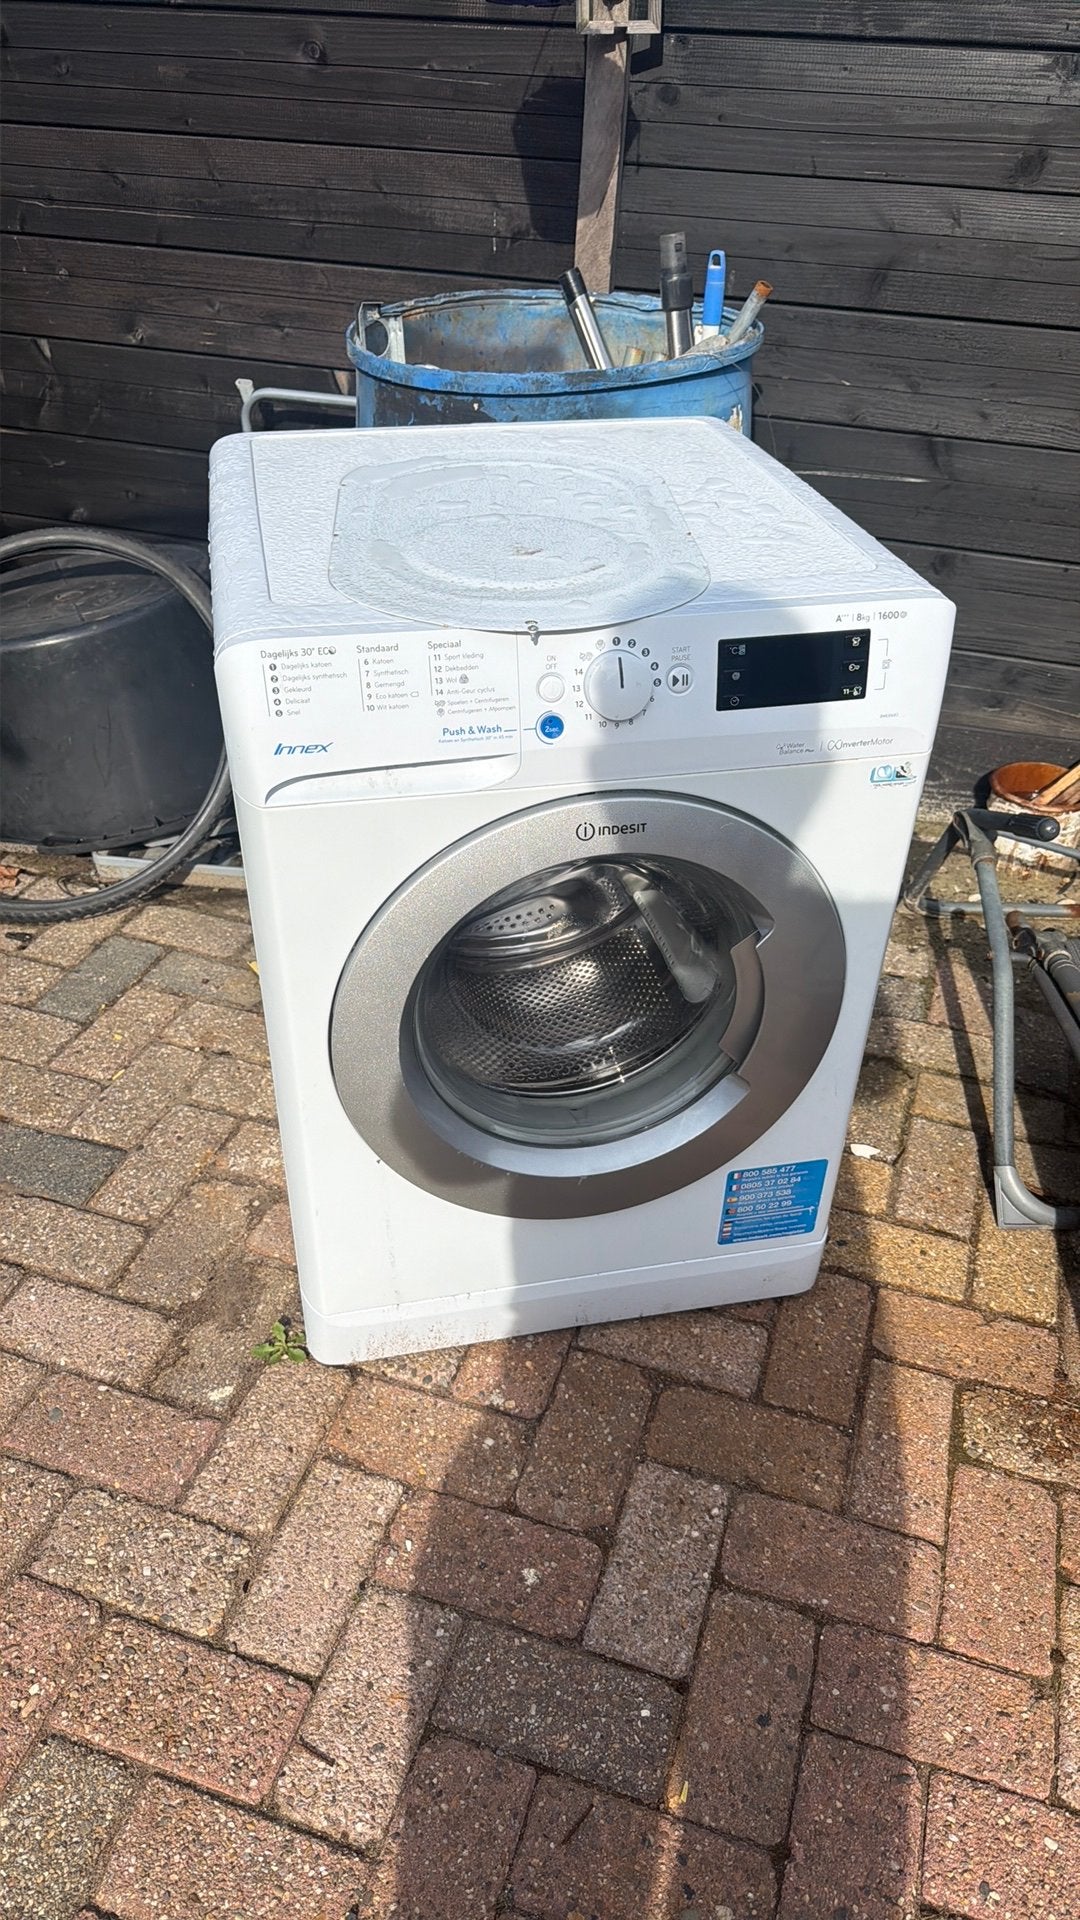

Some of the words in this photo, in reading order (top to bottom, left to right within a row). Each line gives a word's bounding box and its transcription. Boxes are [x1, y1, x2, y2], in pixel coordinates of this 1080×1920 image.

[878, 611, 900, 620] 1600
[356, 643, 399, 654] Standaard
[427, 640, 462, 651] Speciaal
[260, 649, 299, 660] Dagelijks
[300, 647, 315, 656] 30°
[444, 653, 460, 661] Sport
[462, 652, 484, 660] kleding
[671, 654, 692, 662] PAUSE
[281, 662, 309, 671] Dagelijks
[364, 658, 369, 666] 6
[574, 668, 583, 676] 14
[282, 674, 311, 683] Dagelijks
[575, 700, 584, 708] 12
[598, 720, 607, 728] 10
[442, 727, 466, 736] Push
[467, 726, 475, 735] &
[477, 724, 502, 734] Wash
[274, 742, 334, 756] Innex
[598, 823, 647, 836] INDESIT
[742, 1170, 759, 1178] 800
[761, 1168, 777, 1176] 585
[779, 1165, 796, 1173] 477
[740, 1181, 763, 1190] 0805
[765, 1179, 776, 1187] 37
[790, 1176, 802, 1184] 84
[756, 1190, 774, 1199] 373
[775, 1189, 792, 1197] 538
[755, 1203, 767, 1211] 50
[769, 1201, 780, 1209] 22
[781, 1200, 793, 1208] 99
